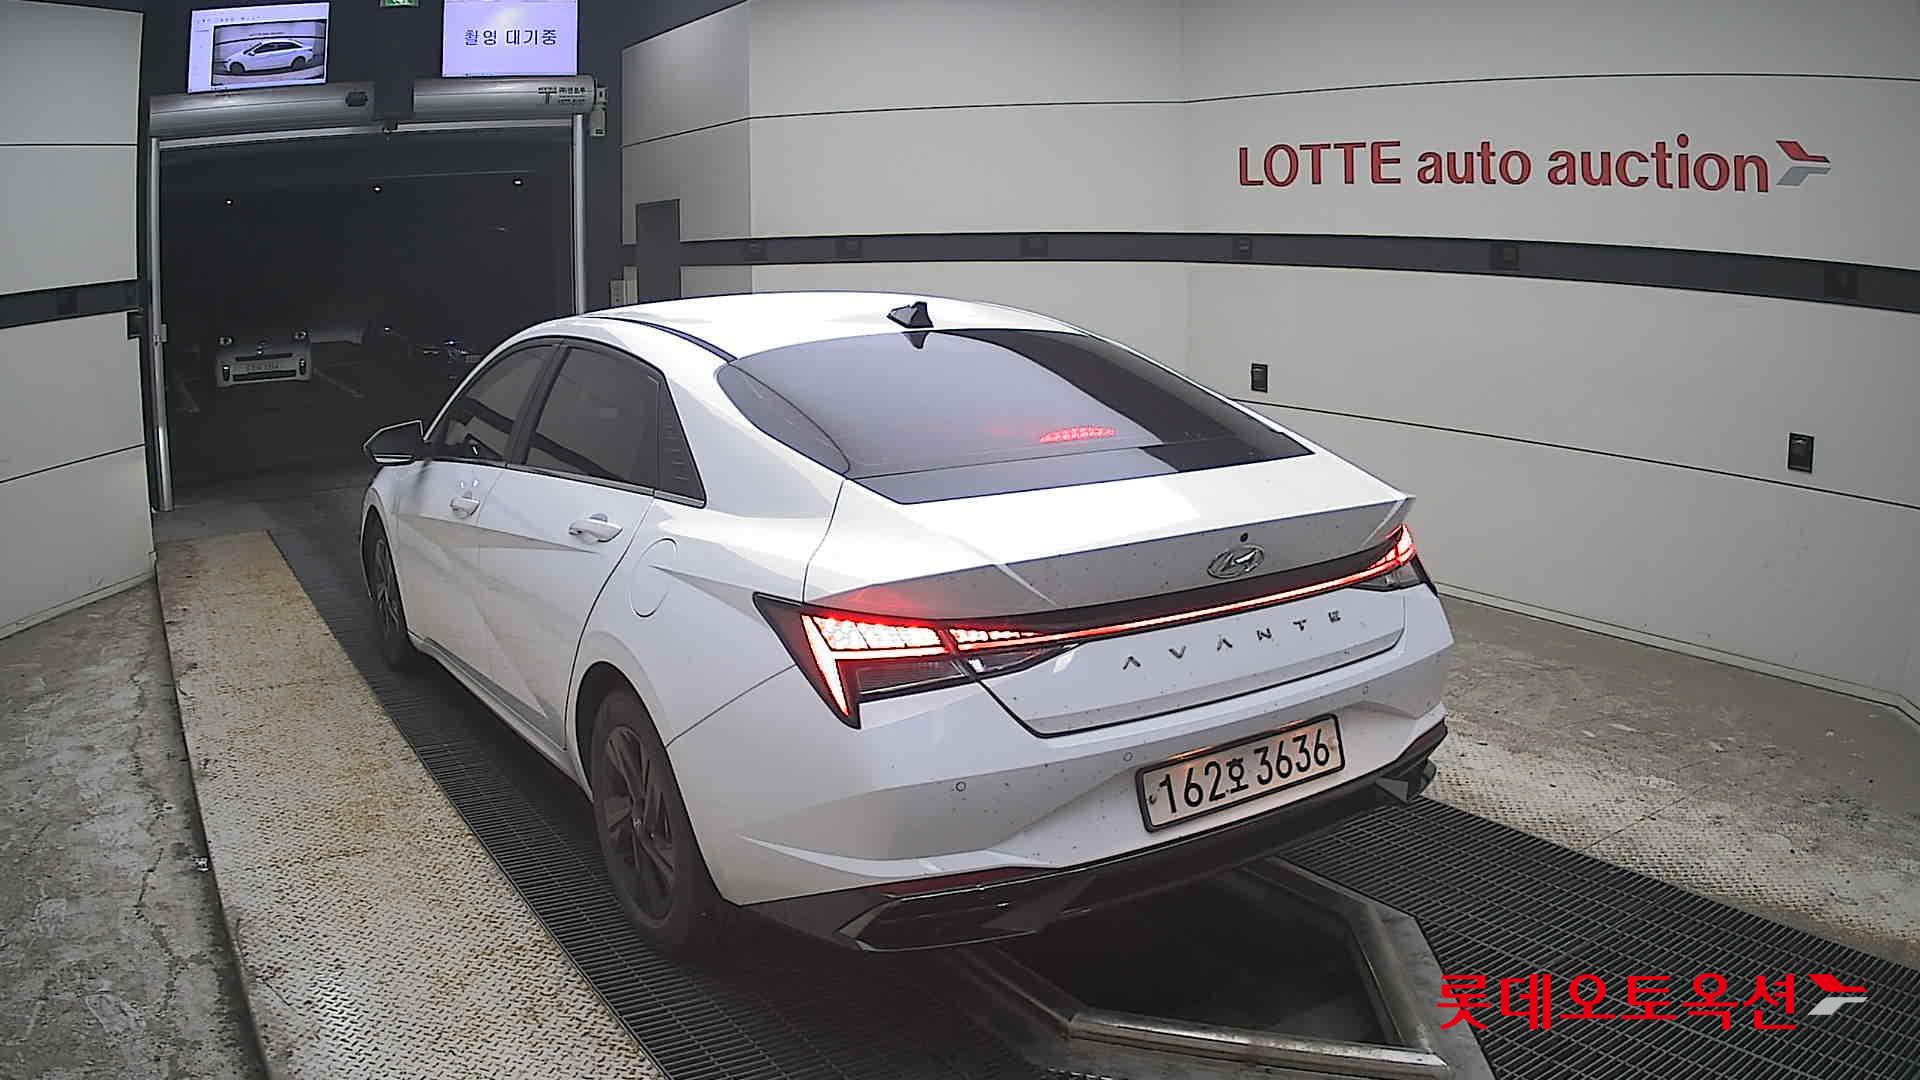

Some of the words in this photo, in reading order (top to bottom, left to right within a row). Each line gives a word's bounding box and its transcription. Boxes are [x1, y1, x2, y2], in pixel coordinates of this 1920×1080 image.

[505, 29, 557, 46] 대기중
[1238, 140, 1400, 188] LOTTE
[1416, 140, 1532, 186] auto
[1547, 133, 1770, 193] auction
[1122, 610, 1342, 671] AVANTE
[1158, 757, 1249, 814] 162호
[1253, 728, 1330, 786] 3636
